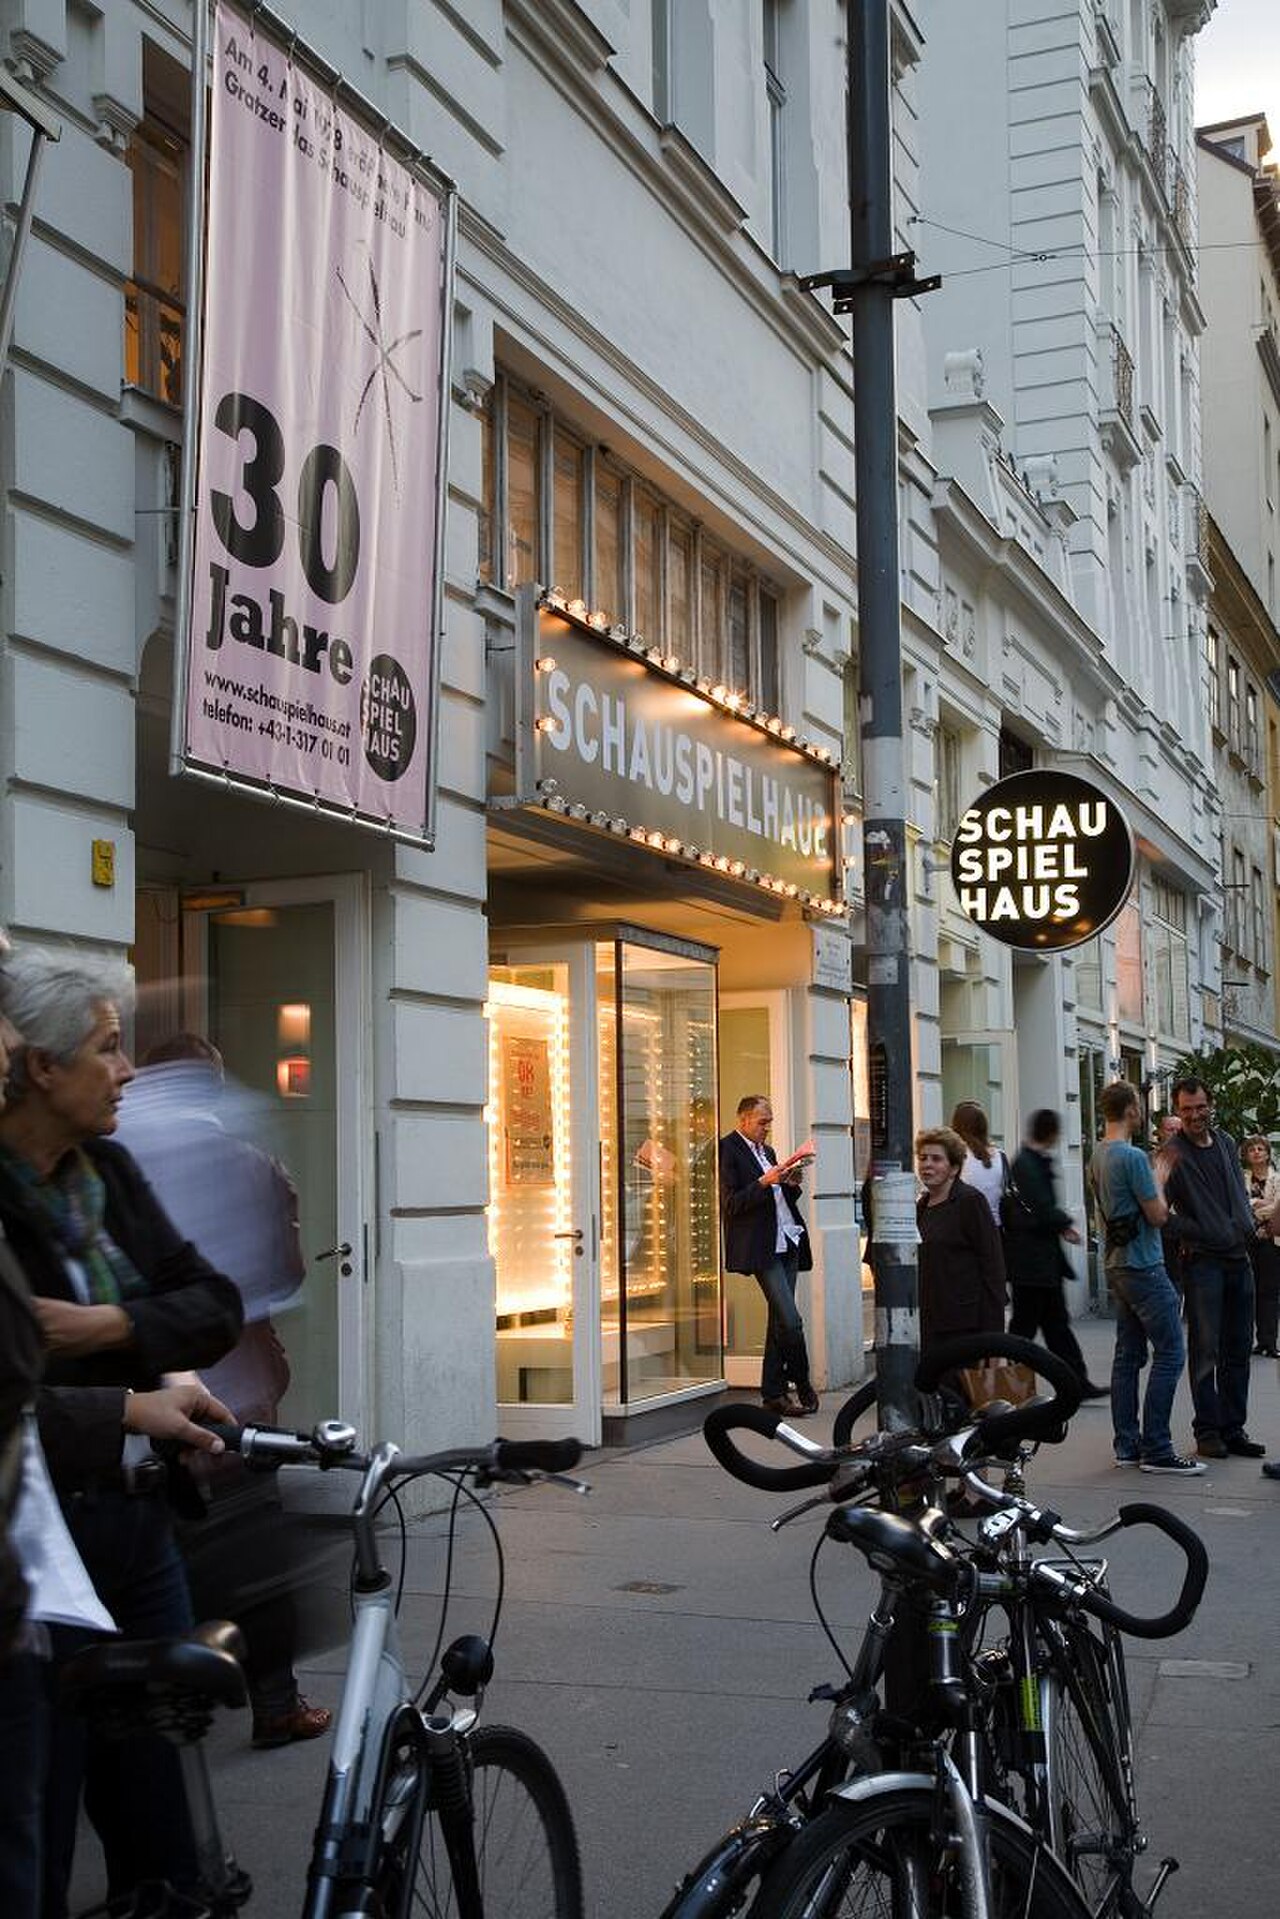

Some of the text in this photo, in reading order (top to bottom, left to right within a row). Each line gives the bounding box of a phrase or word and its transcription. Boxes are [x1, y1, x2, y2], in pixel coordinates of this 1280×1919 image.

[225, 37, 252, 75] Am
[257, 65, 273, 93] 4.
[314, 108, 343, 151] 198
[225, 70, 286, 132] Gratzer
[210, 392, 360, 604] 30
[205, 561, 354, 686] Jahre
[203, 698, 253, 733] telefon:
[204, 671, 350, 739] www.schauspielhaus.at
[362, 700, 402, 736] SPIEL
[957, 802, 1107, 843] SCHAU
[957, 844, 1088, 883] SPIEL
[960, 884, 1080, 922] HAUS
